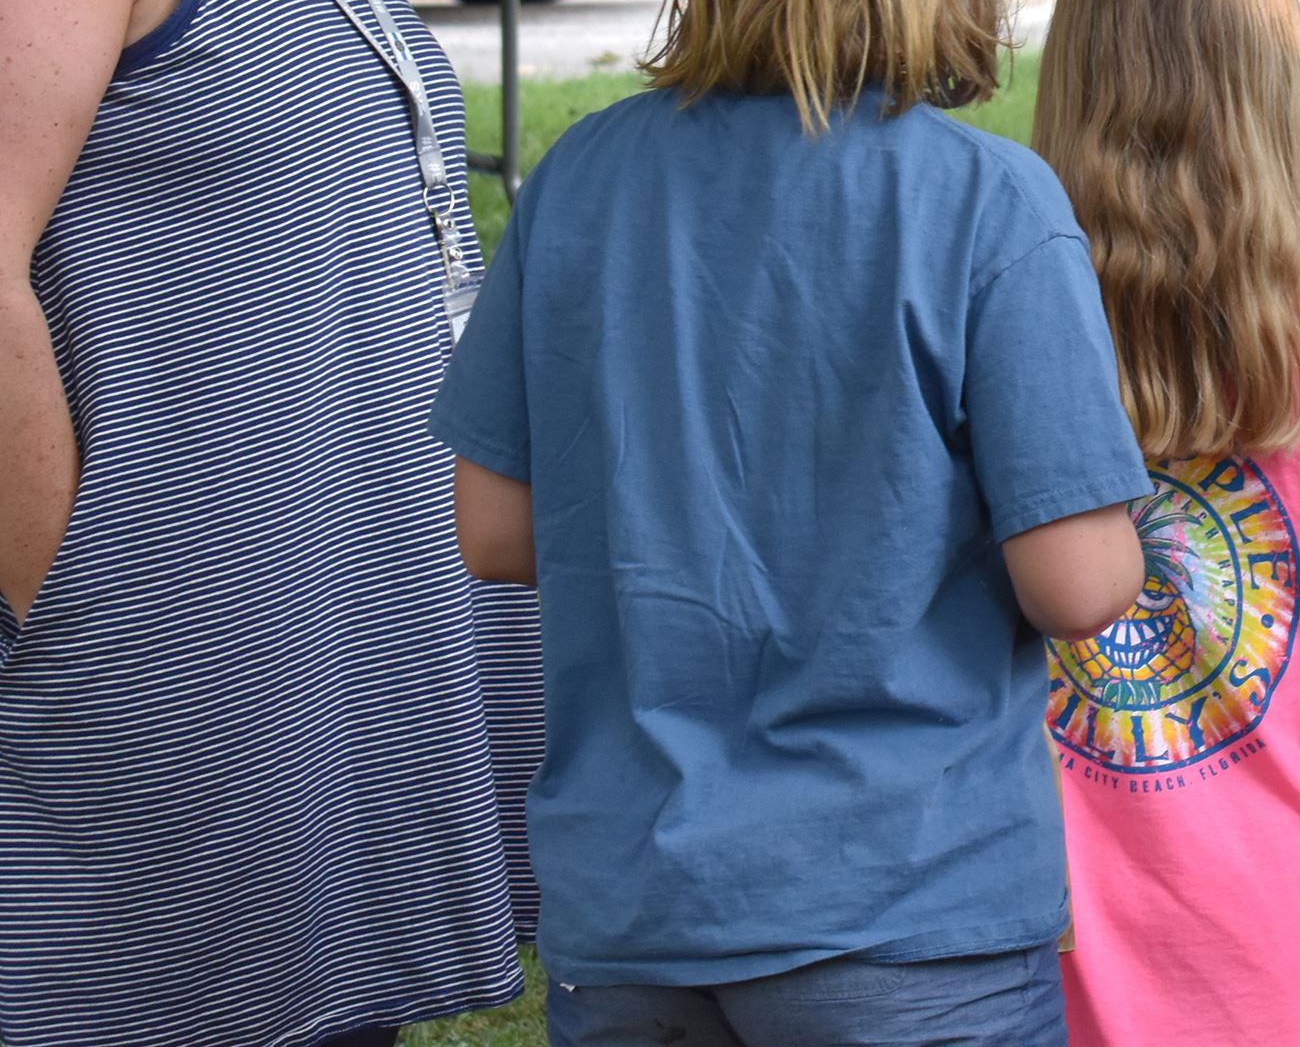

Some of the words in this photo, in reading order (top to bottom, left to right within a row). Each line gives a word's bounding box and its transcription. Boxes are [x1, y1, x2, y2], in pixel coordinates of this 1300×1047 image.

[1050, 658, 1272, 763] ILLY'S
[1084, 765, 1120, 790] CITY
[1198, 738, 1267, 781] FLORIDA
